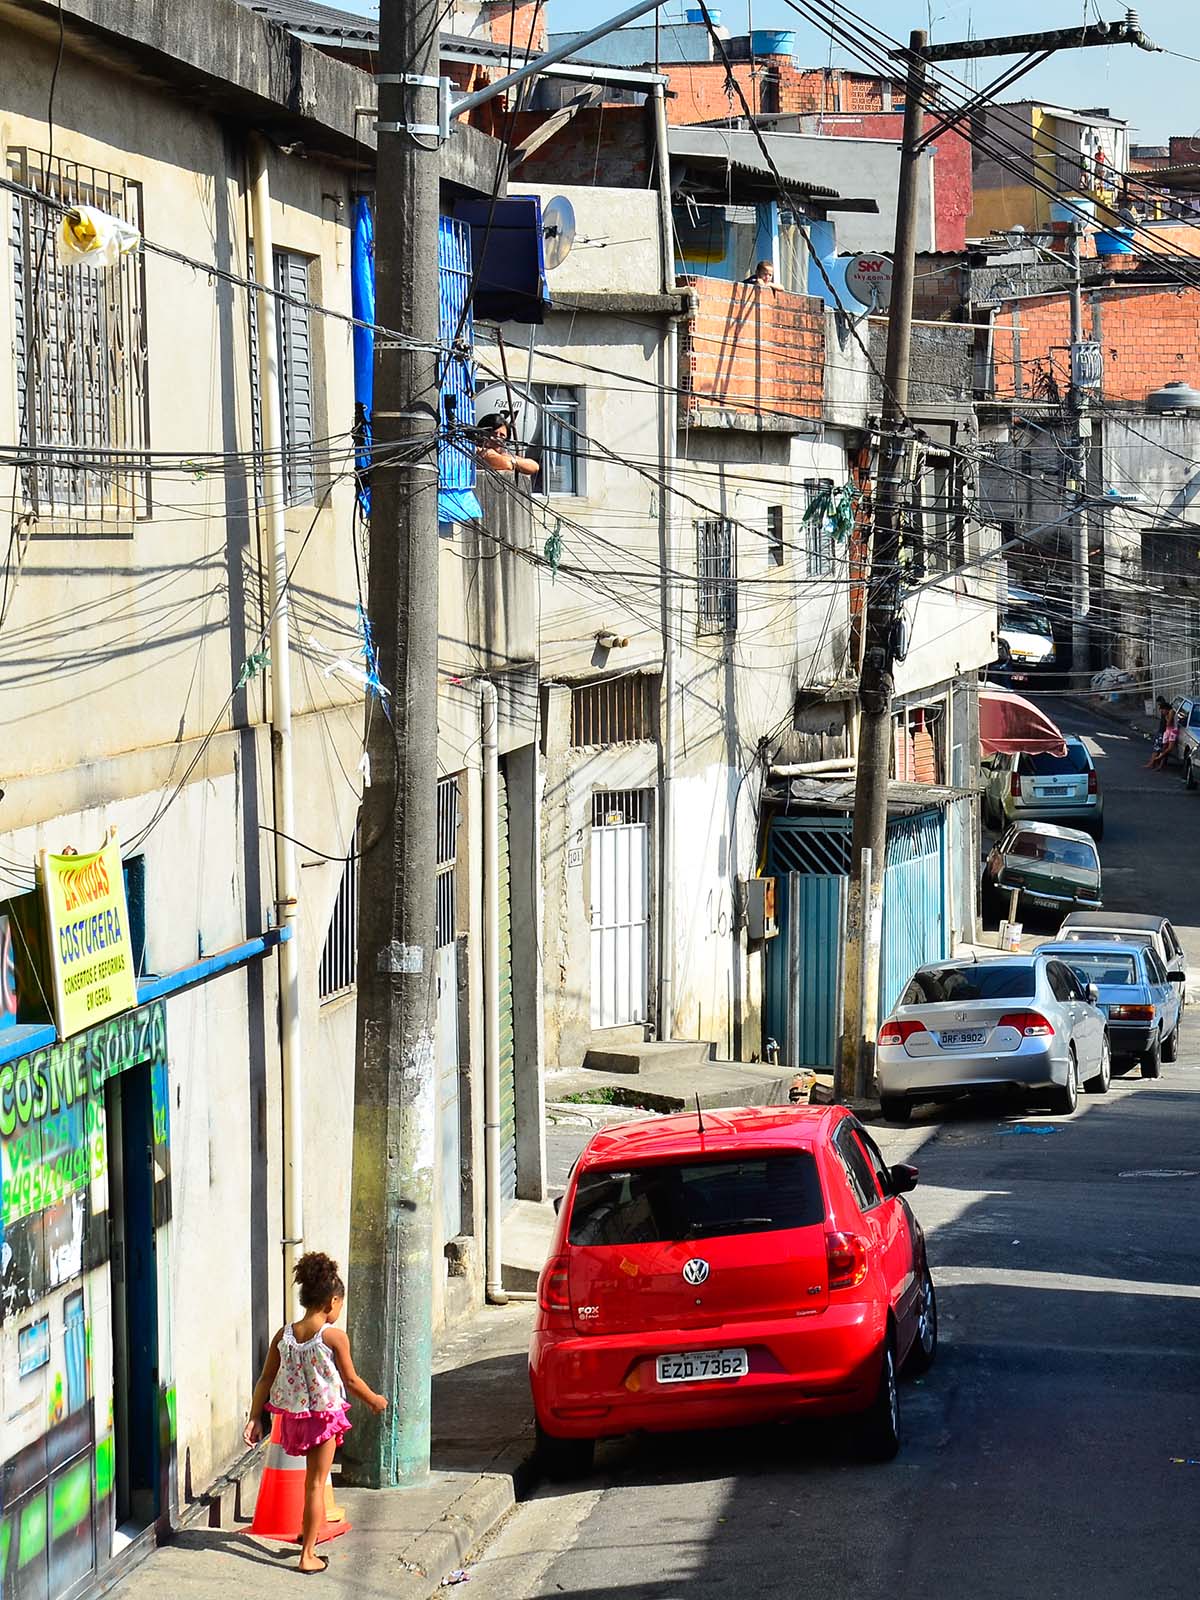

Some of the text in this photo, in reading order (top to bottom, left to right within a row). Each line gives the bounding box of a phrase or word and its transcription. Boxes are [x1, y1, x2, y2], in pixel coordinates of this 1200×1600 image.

[858, 260, 885, 273] SKY
[59, 906, 123, 965] COSTUREIRA
[64, 954, 125, 996] CONSERTOS E REFORMAS
[86, 985, 112, 1011] EM GERAL
[0, 1002, 167, 1136] COSME SOUZA
[8, 1114, 69, 1174] VENDA
[578, 1306, 599, 1314] FOX
